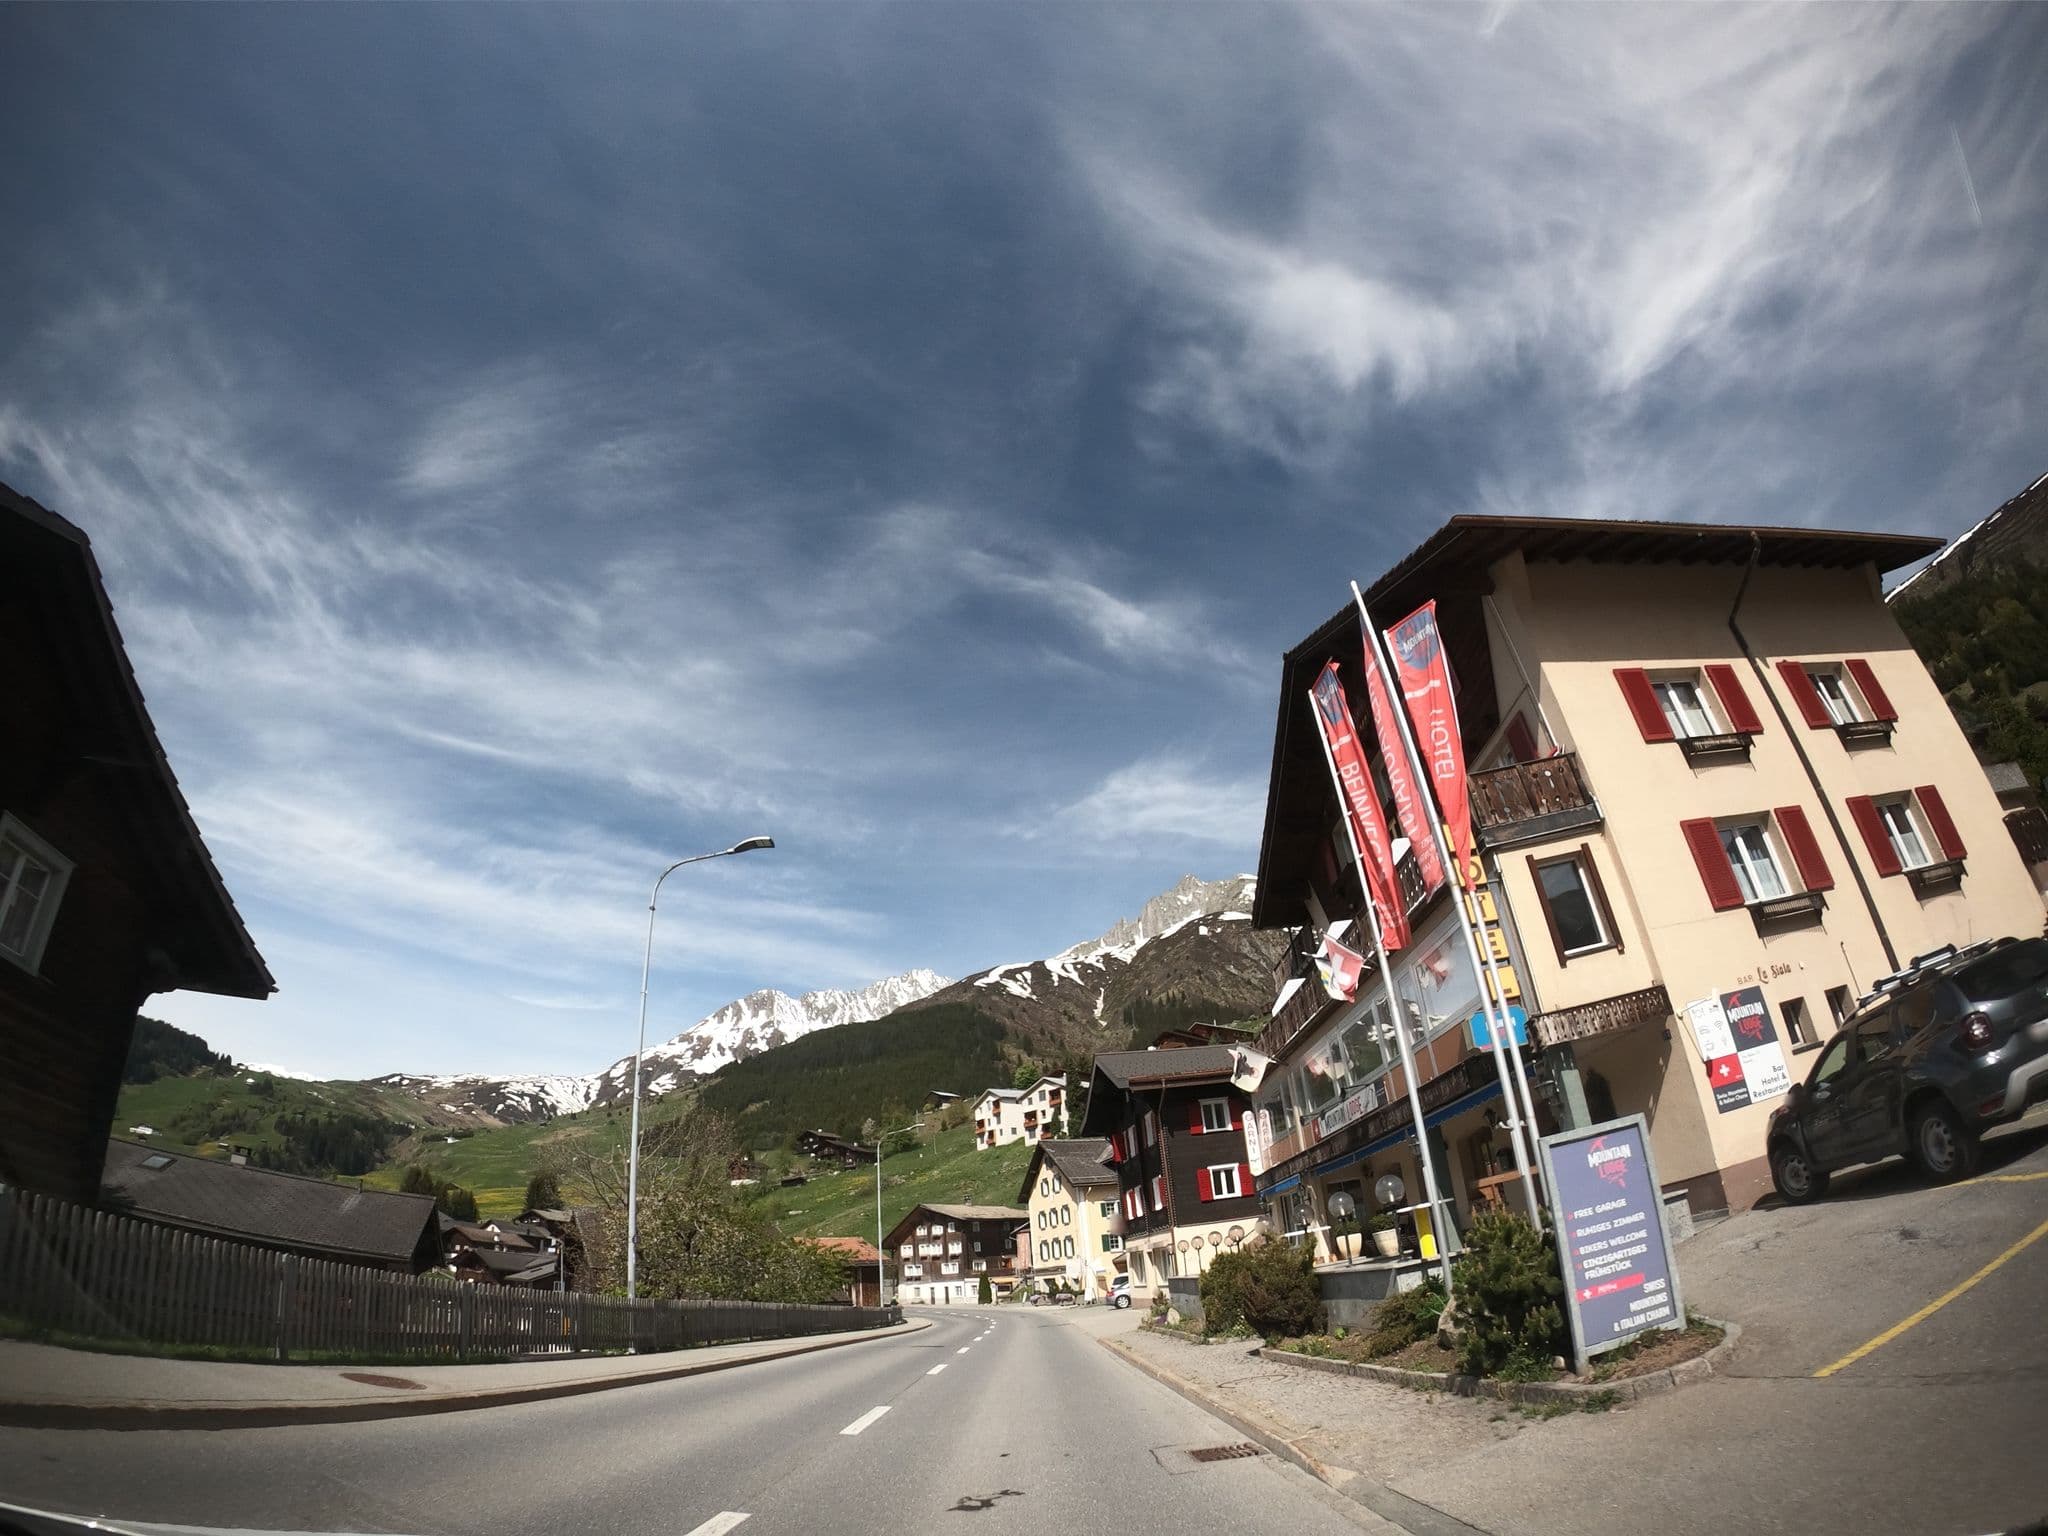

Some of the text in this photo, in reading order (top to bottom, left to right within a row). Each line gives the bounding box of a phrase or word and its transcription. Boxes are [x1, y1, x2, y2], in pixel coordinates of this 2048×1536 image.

[1737, 974, 1753, 985] BAR
[1726, 1001, 1765, 1023] MOUNTAIN
[1772, 1064, 1784, 1072] Bar
[1752, 1082, 1790, 1098] Restaurant
[1761, 1073, 1781, 1086] Hotel
[1587, 1143, 1632, 1168] MOUNTAIN
[1573, 1198, 1627, 1219] FREE GARAGE
[1576, 1211, 1645, 1237] RUHIGES ZIMMER
[1579, 1229, 1648, 1255] BIKERS WELCOME
[1583, 1244, 1647, 1269] EINZIGARTIGES
[1585, 1260, 1632, 1280] FRÜHSTÜCK
